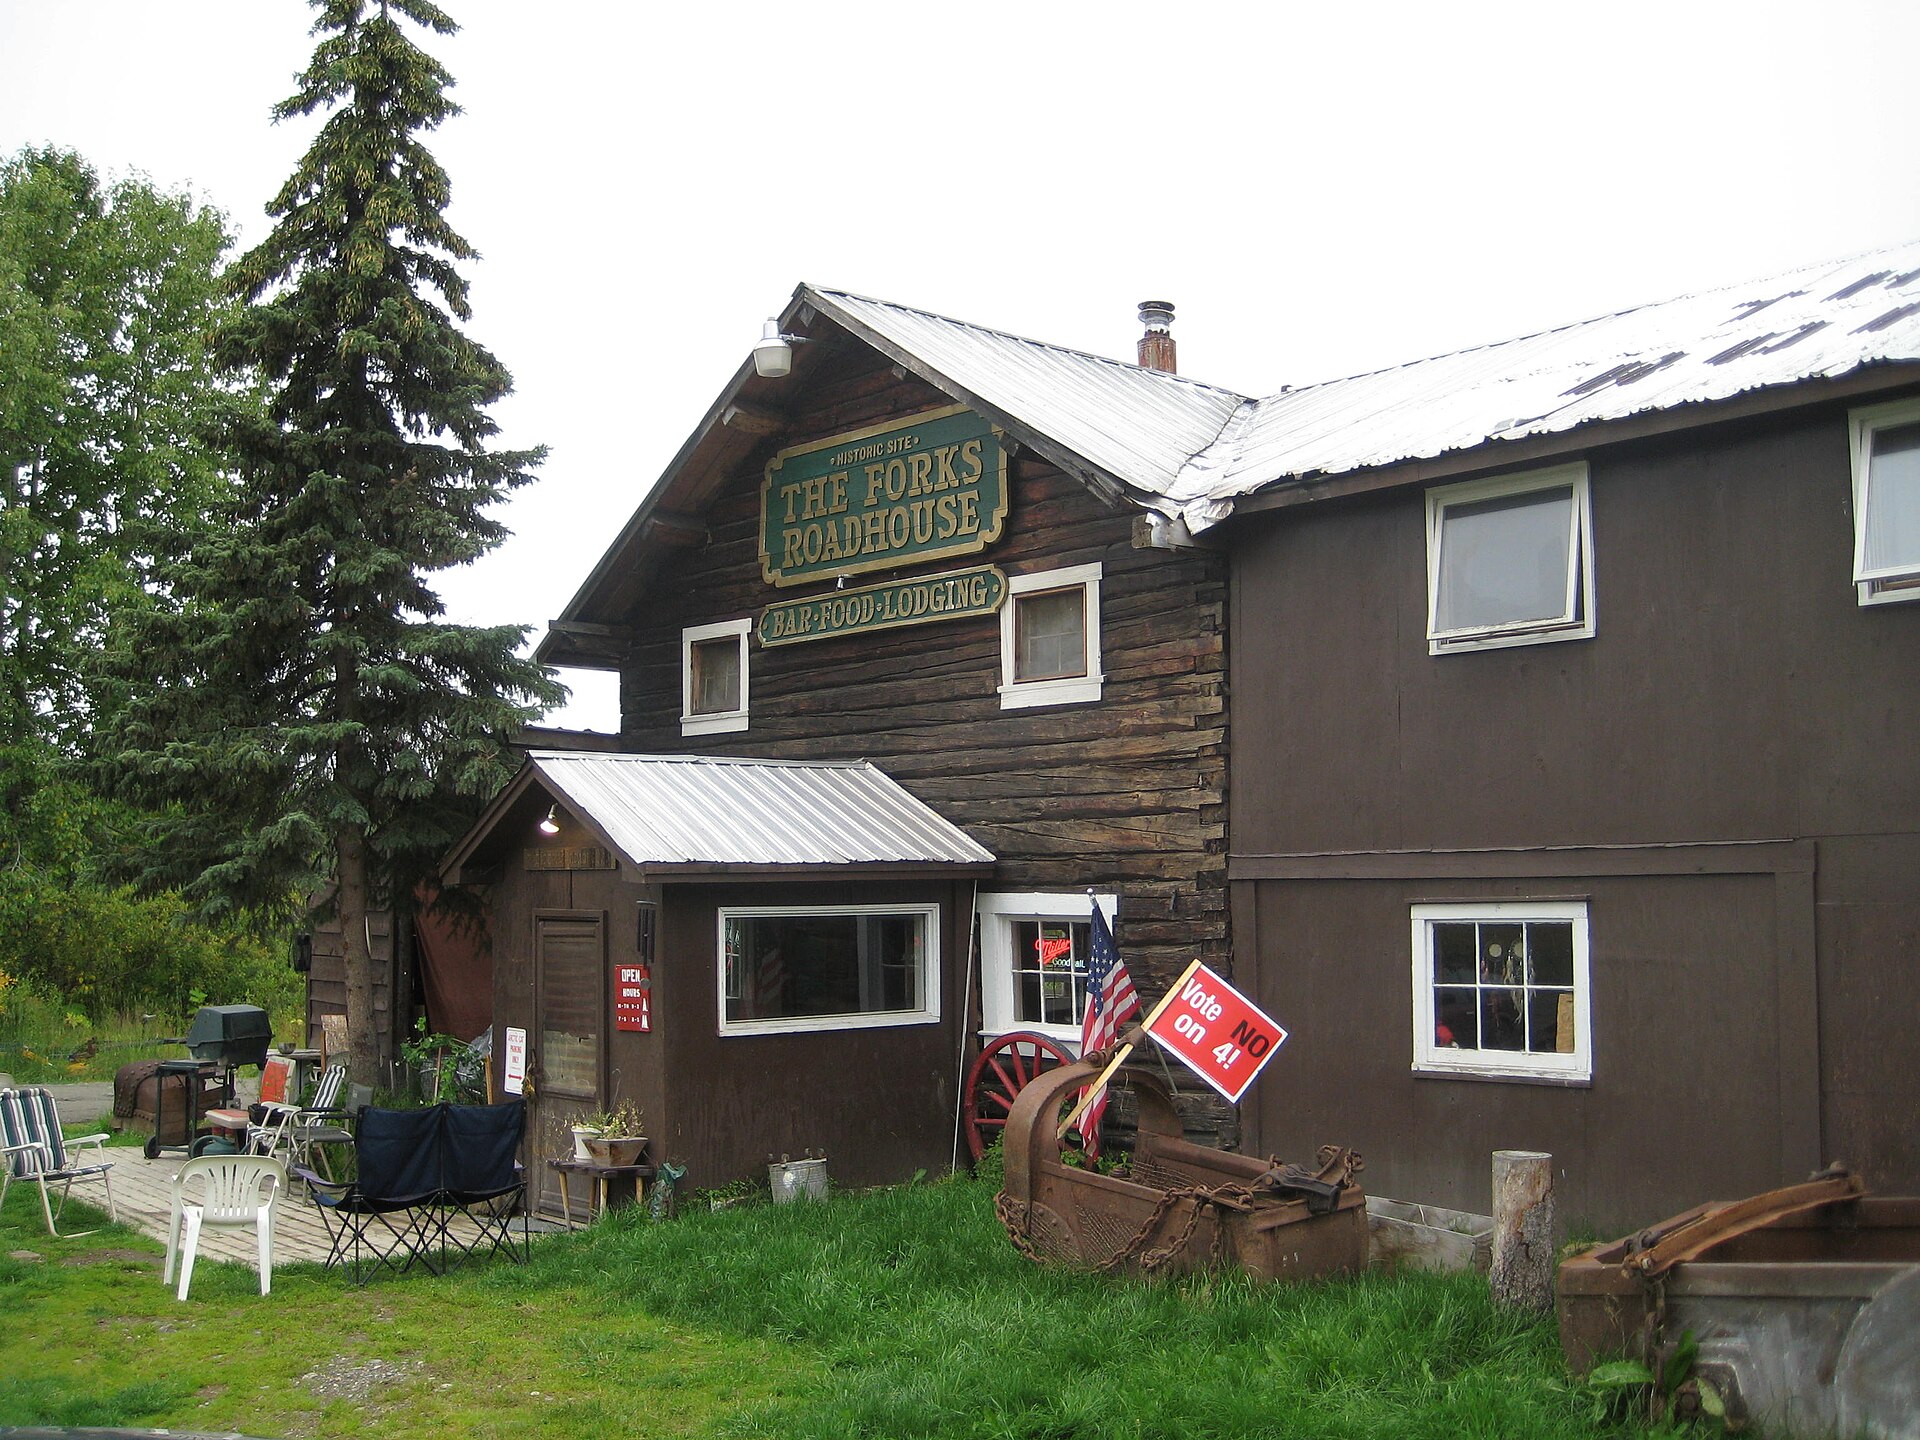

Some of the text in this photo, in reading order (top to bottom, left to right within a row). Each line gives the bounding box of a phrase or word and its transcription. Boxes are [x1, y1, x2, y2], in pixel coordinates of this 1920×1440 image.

[836, 435, 912, 466] HISTORIC SITE
[781, 439, 983, 524] THE FORKS
[782, 490, 981, 569] ROADHOUSE
[1035, 939, 1071, 961] Miller
[1053, 957, 1070, 967] Good
[621, 969, 641, 983] OPEN
[622, 988, 640, 998] HOURS
[1180, 977, 1270, 1058] Vote NO
[1174, 1013, 1206, 1045] on
[1212, 1042, 1241, 1070] 4!
